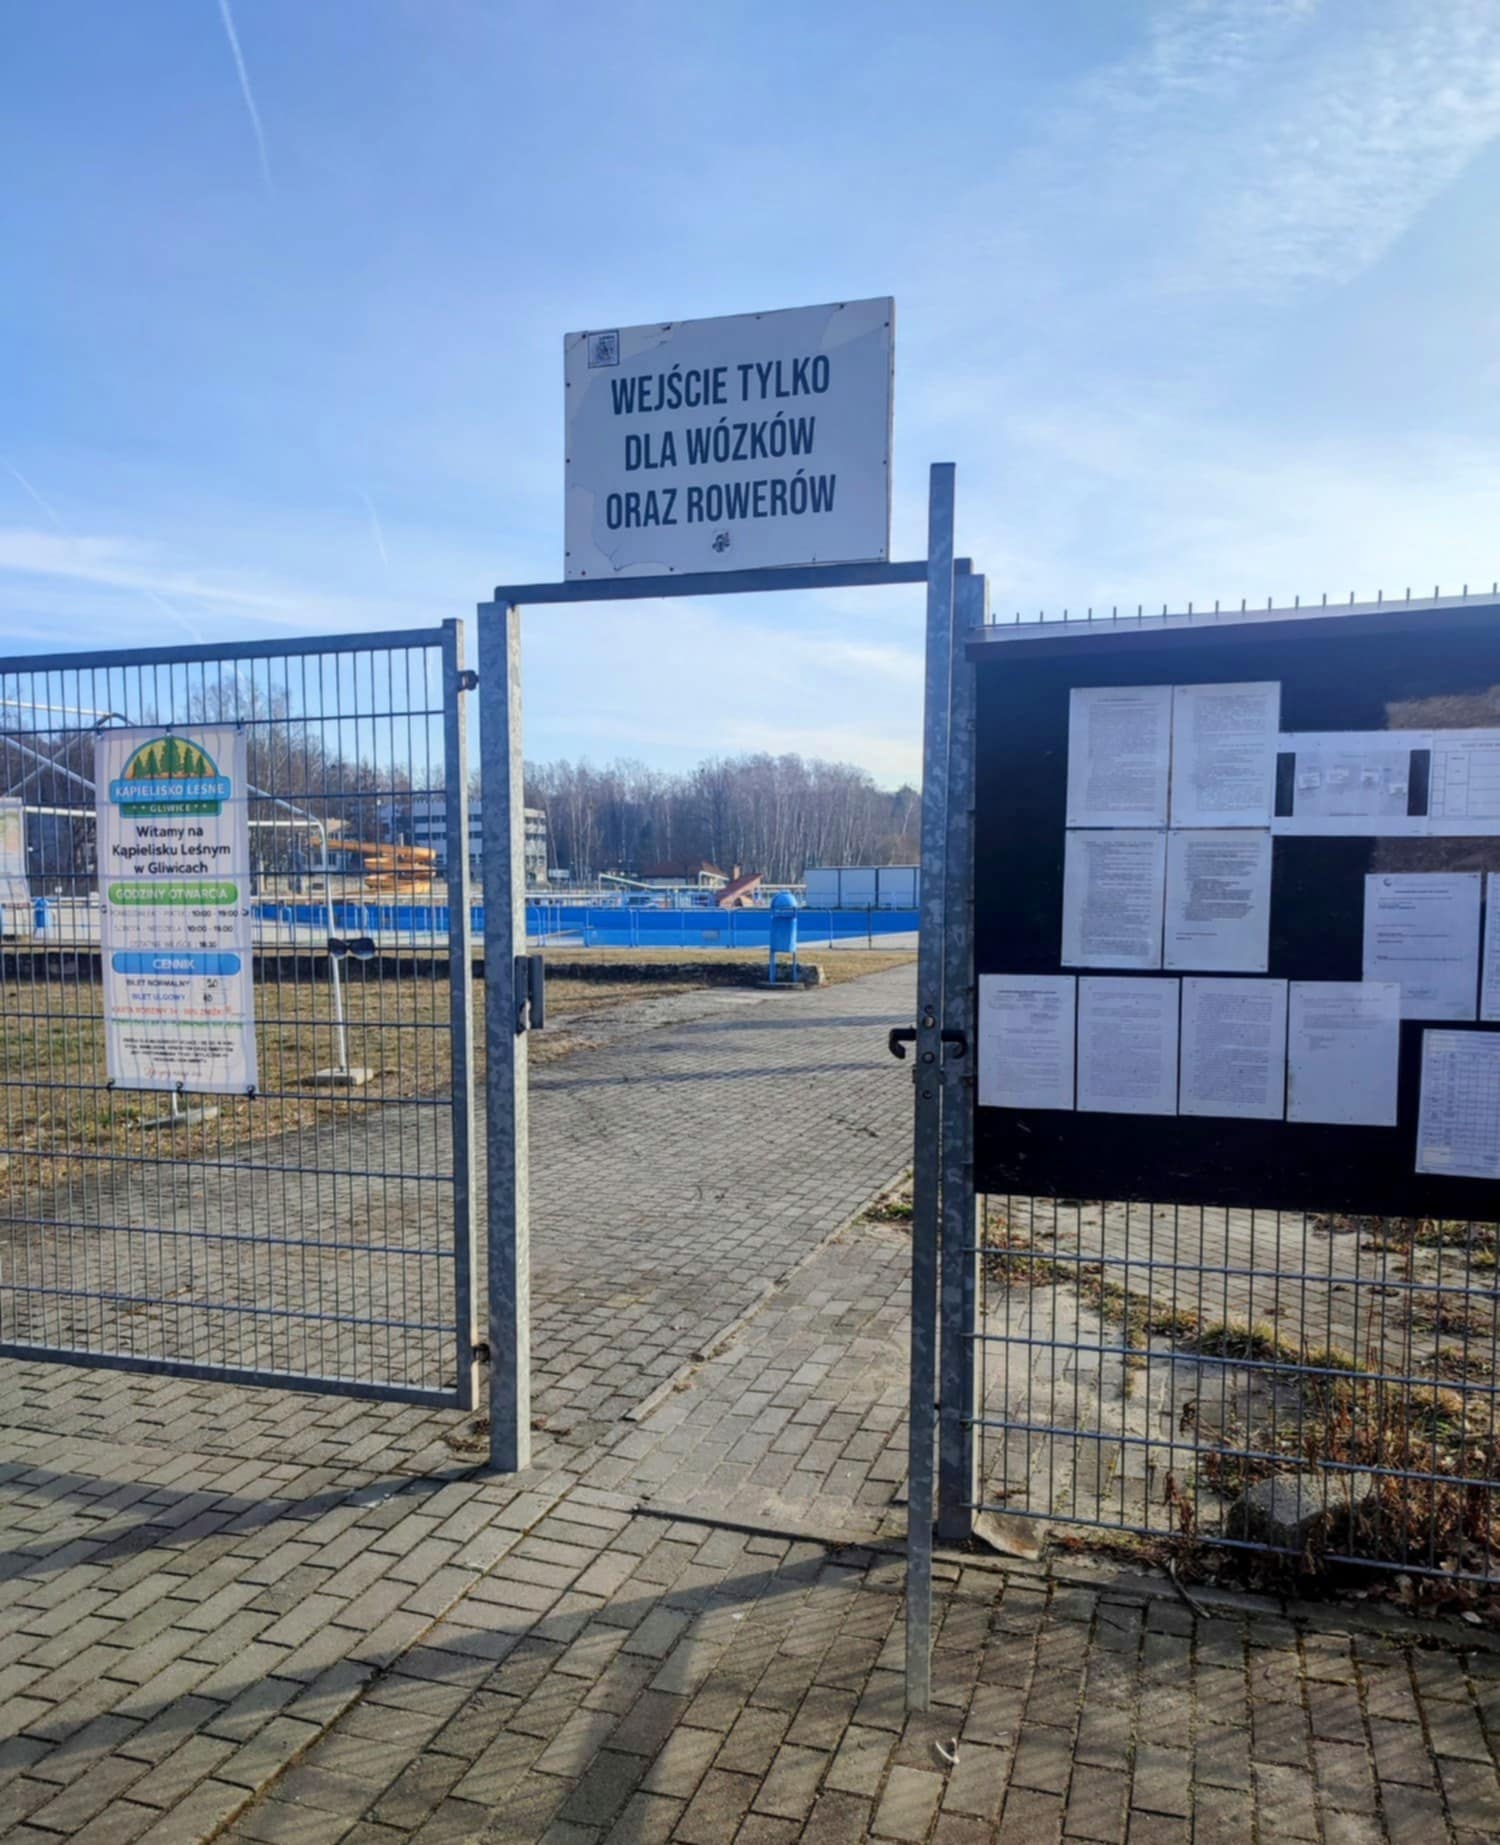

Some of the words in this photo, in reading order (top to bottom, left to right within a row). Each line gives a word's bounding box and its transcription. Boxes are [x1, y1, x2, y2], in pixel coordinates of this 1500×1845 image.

[611, 363, 728, 416] WEJŚCIE
[737, 354, 831, 402] TYLKO
[624, 431, 678, 472] DLA
[686, 410, 816, 466] WÓZKÓW
[605, 488, 678, 530] ORAZ
[686, 468, 837, 524] ROWERÓW
[150, 803, 191, 813] GLIWICE
[136, 825, 185, 841] Witamy
[187, 826, 204, 837] na
[112, 843, 178, 860] Kąpielisku
[181, 843, 231, 859] Leśnym
[134, 864, 144, 874] w
[148, 861, 209, 874] Gliwicach
[115, 888, 166, 900] GODZINY
